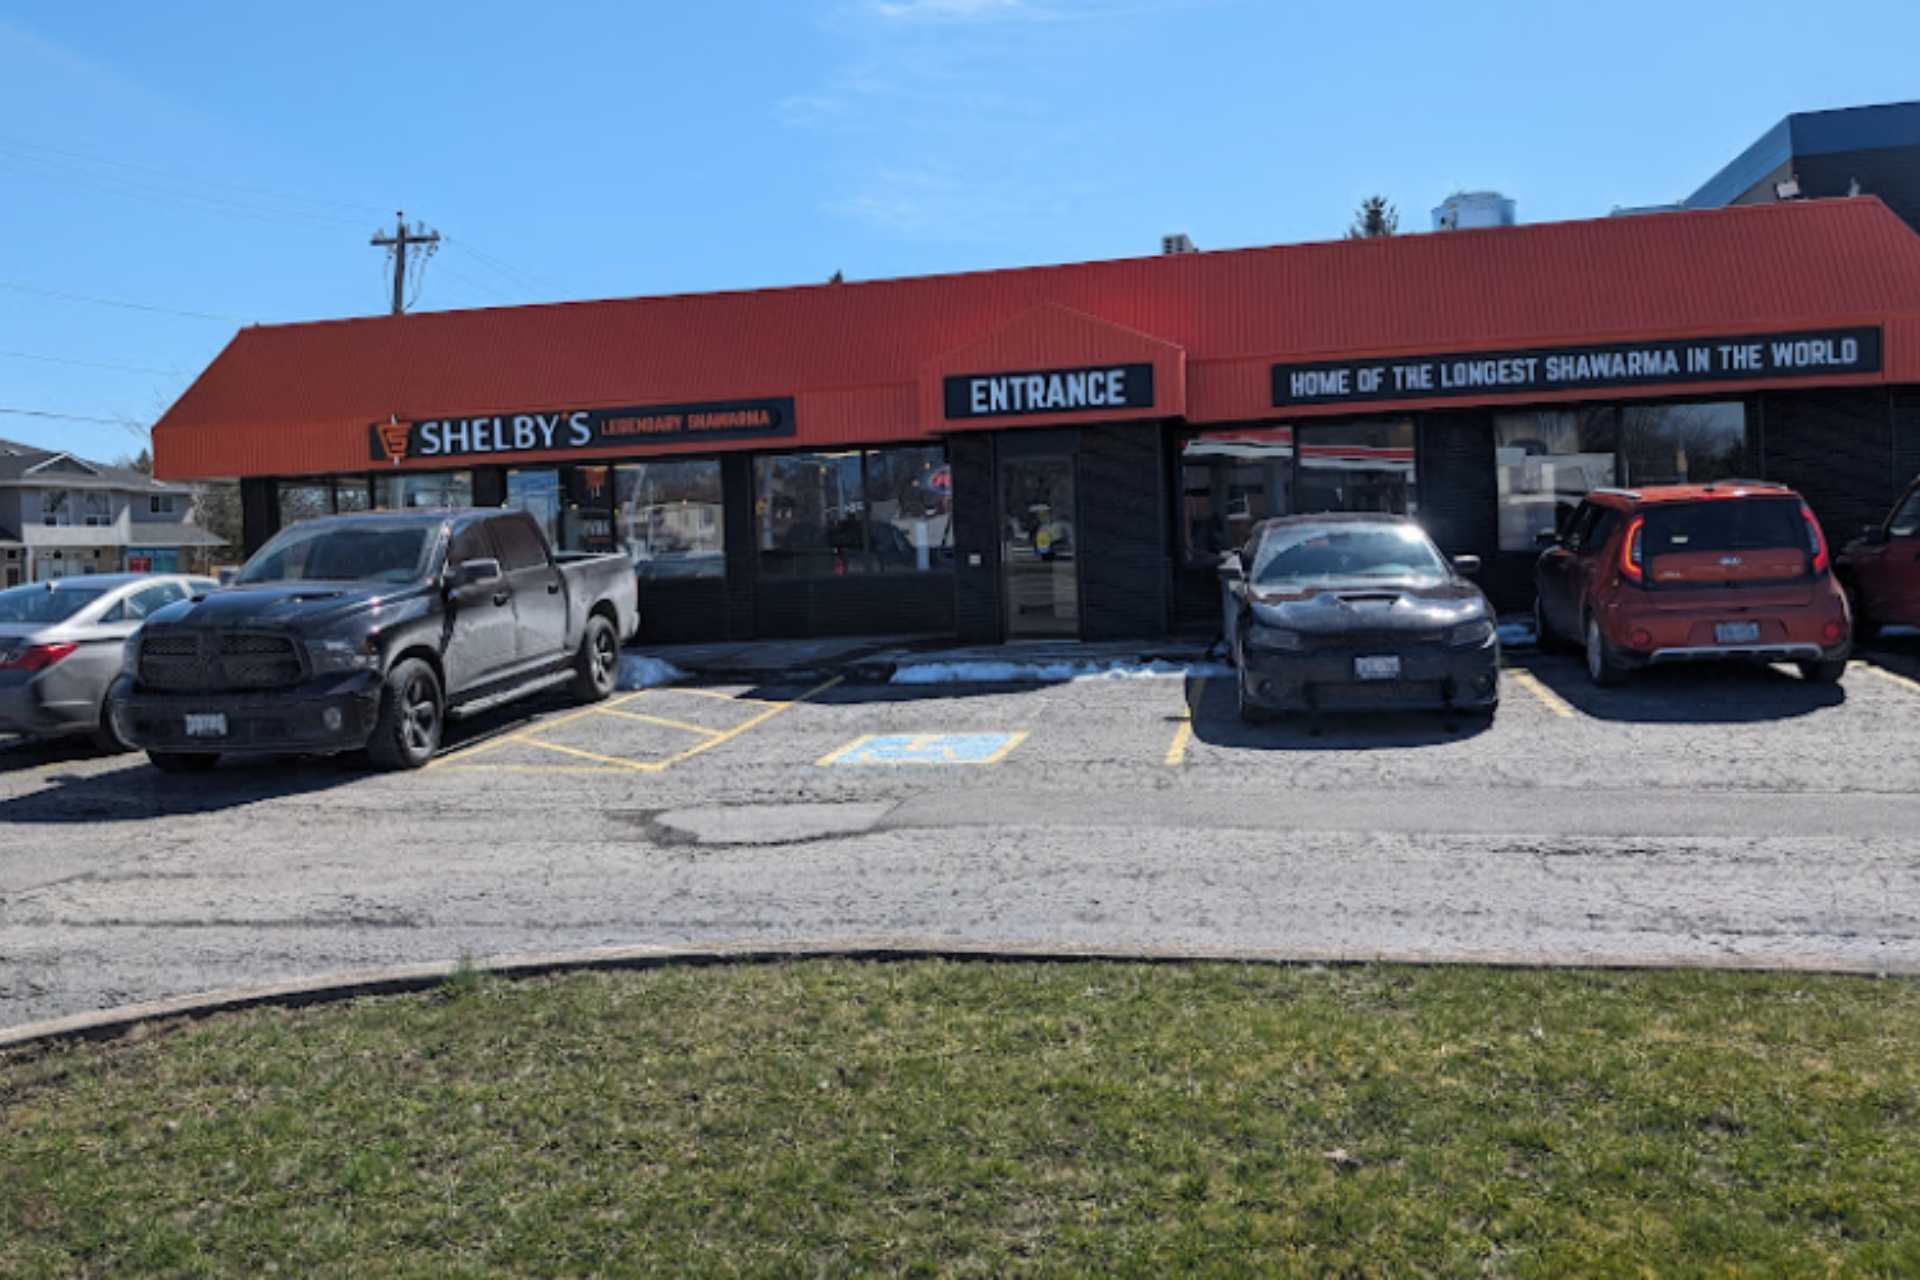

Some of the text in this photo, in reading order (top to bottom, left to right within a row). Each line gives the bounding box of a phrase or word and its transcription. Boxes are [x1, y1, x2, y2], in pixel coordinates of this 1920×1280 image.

[1290, 338, 1858, 397] HOME OF THE LONGEST SHAWARMA IN THE WORLD
[970, 369, 1127, 413] ENTRANCE
[419, 411, 591, 454] SHELBY'S
